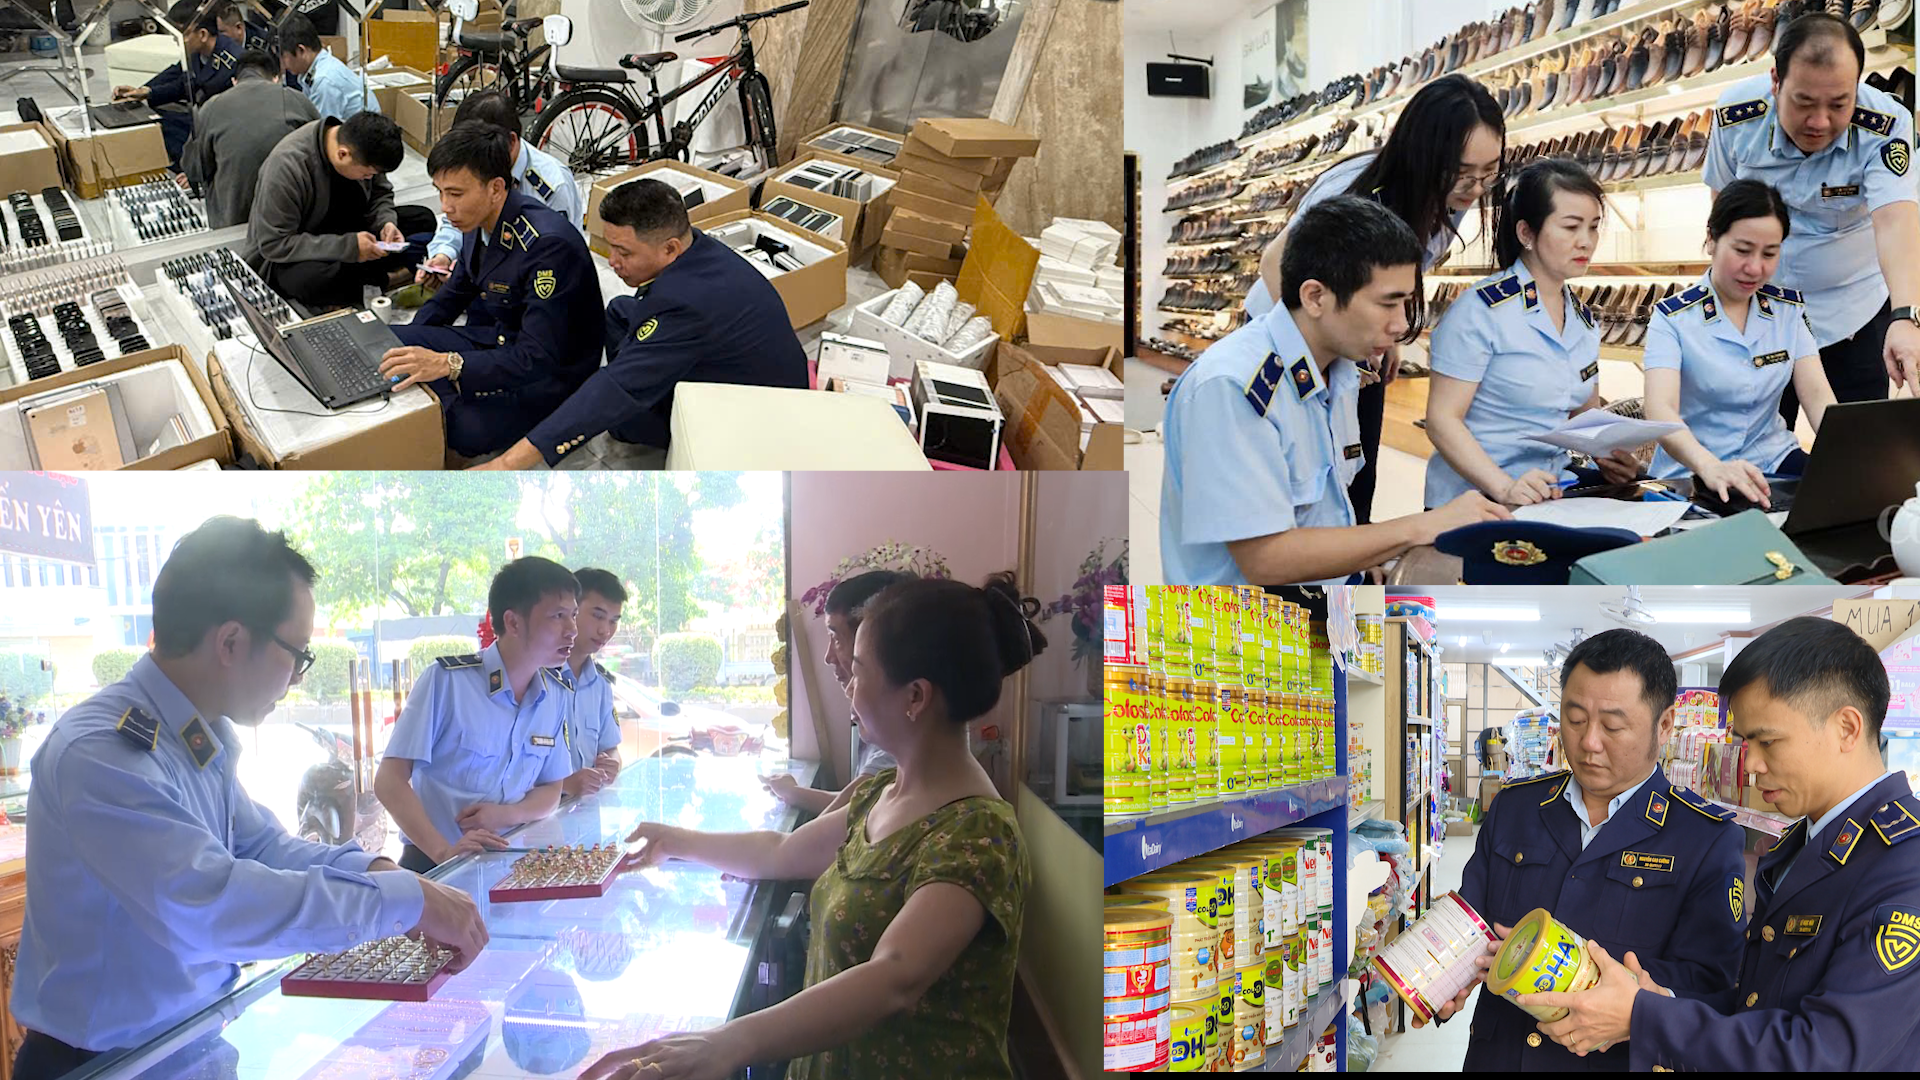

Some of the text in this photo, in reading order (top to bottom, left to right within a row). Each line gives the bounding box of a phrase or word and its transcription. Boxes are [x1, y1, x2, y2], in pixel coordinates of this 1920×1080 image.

[36, 499, 82, 543] YÊN
[1845, 606, 1892, 635] MUA
[1890, 910, 1920, 930] DMS
